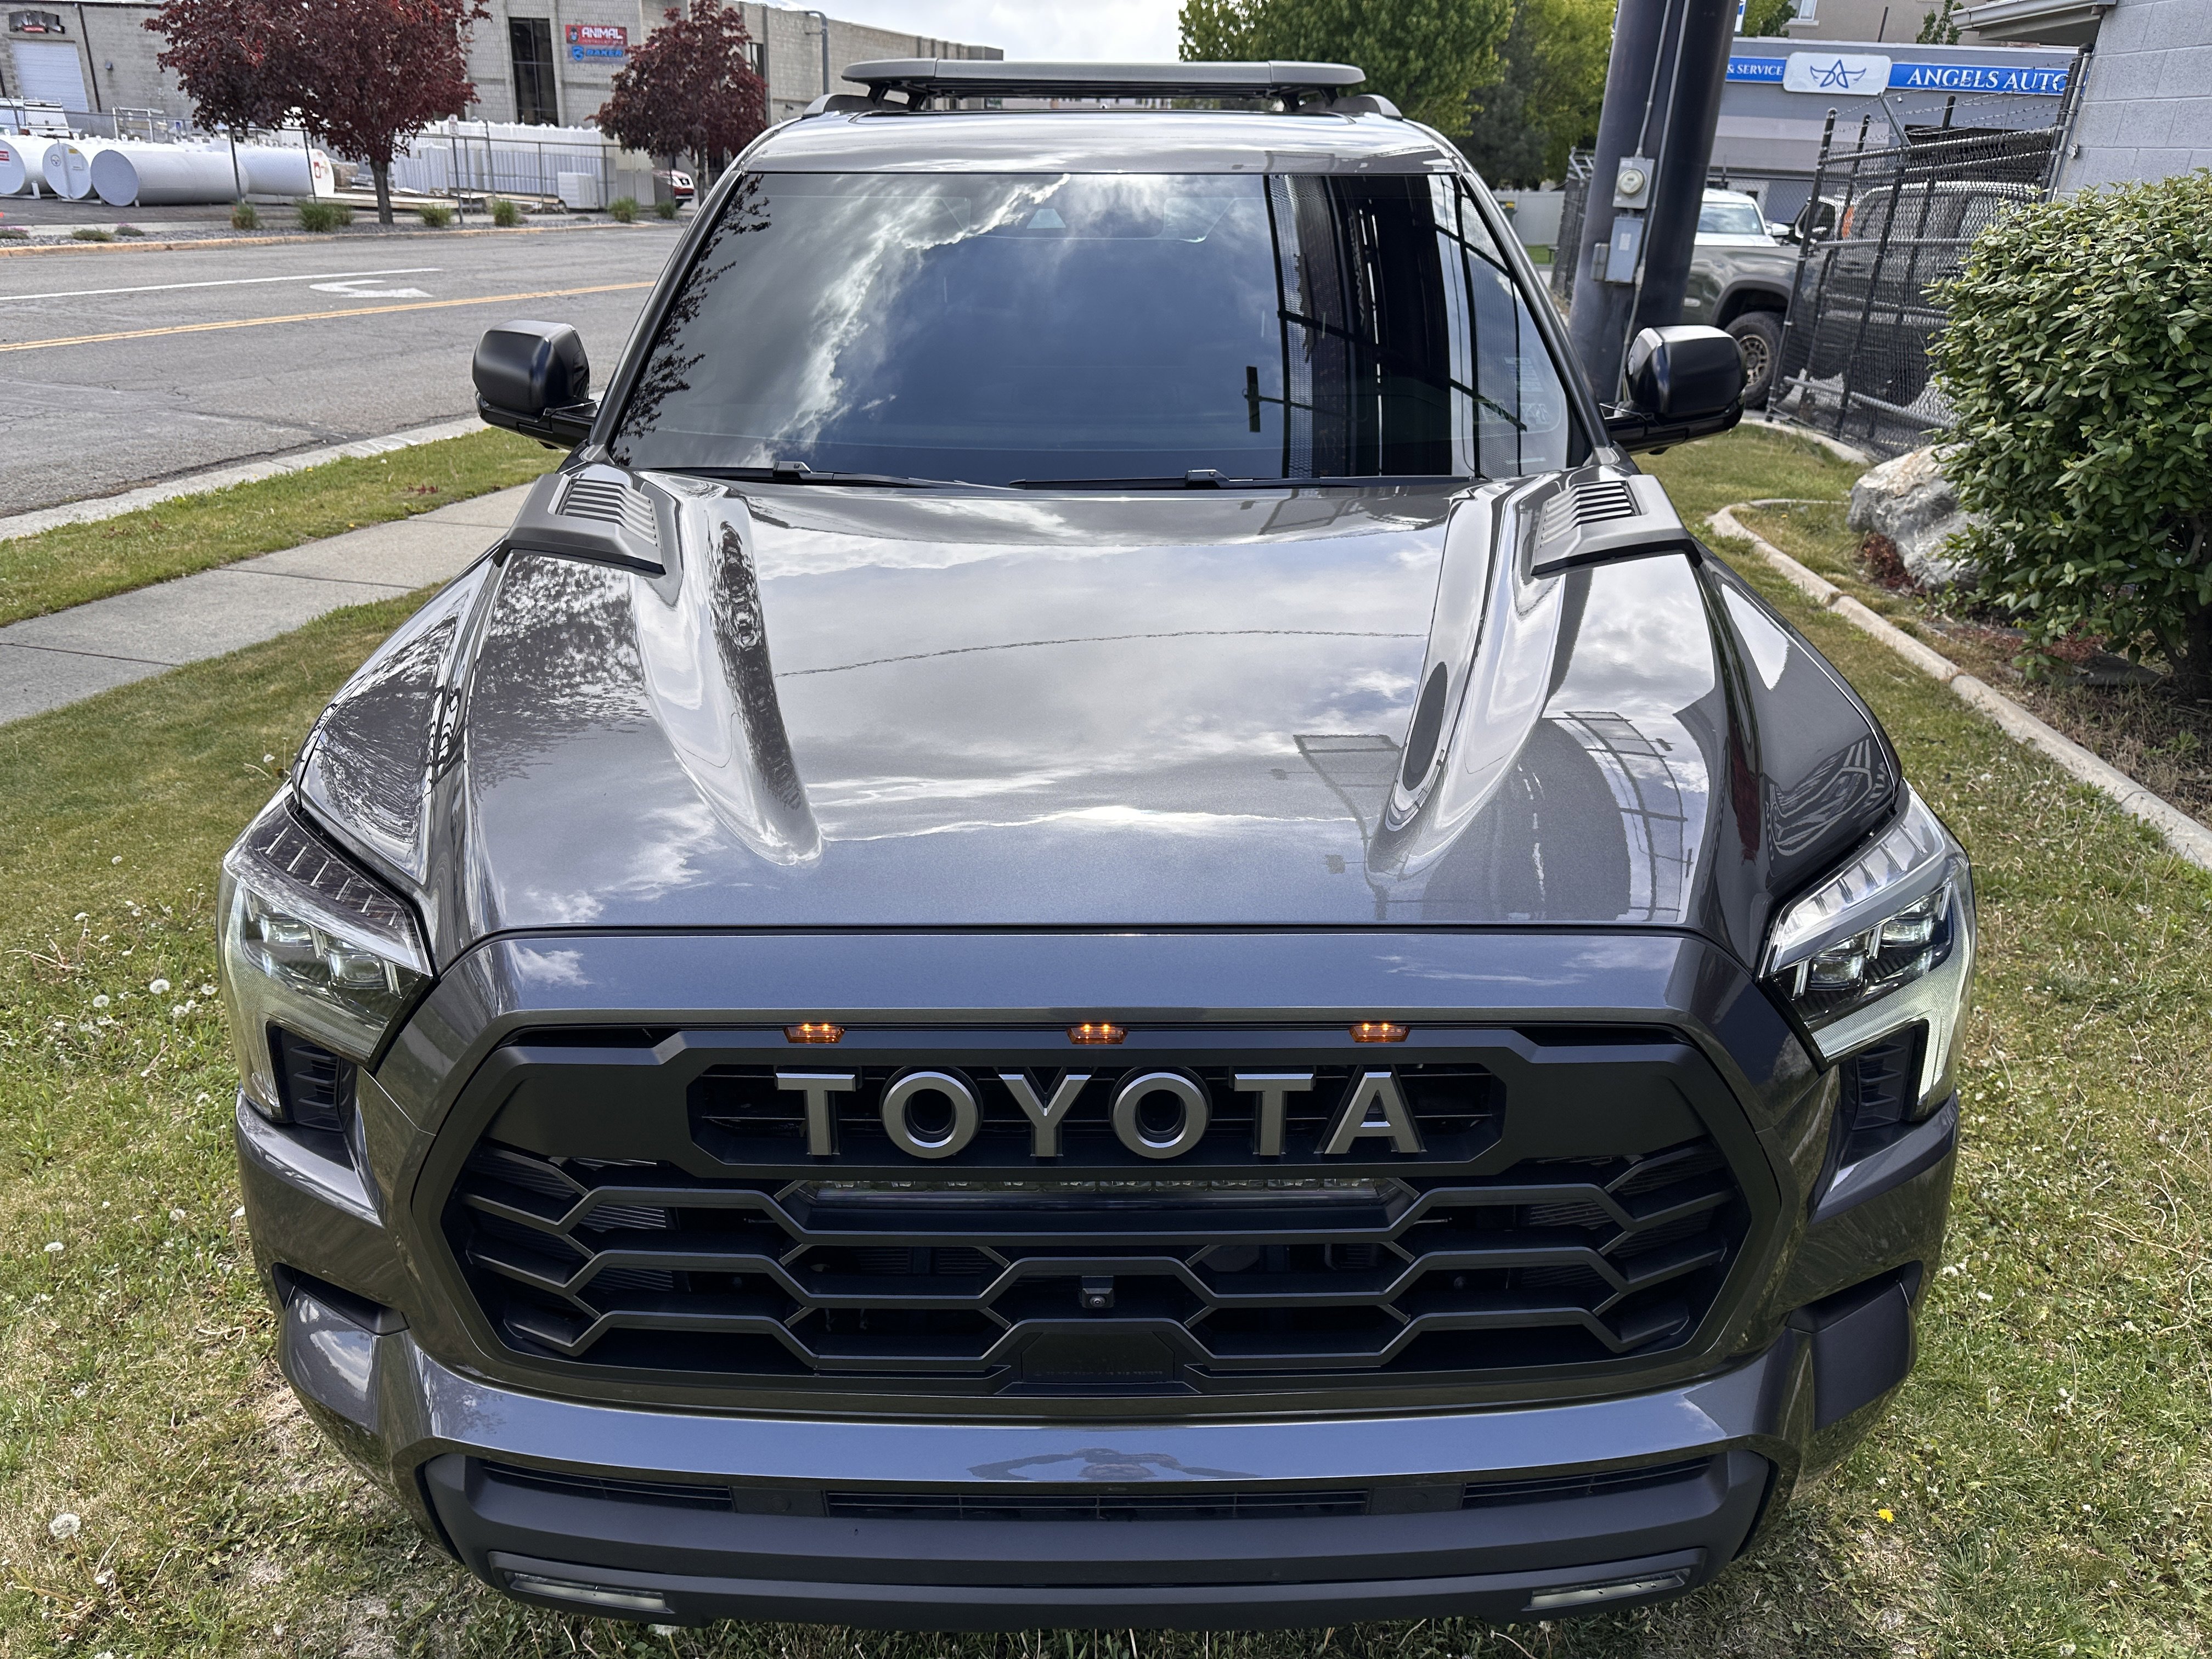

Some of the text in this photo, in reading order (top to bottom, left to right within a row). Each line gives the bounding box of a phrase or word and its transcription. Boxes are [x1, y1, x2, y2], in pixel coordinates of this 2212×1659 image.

[582, 27, 623, 39] ANIMAL
[586, 49, 623, 58] BAKER
[1726, 63, 1784, 76] & SERVICE
[1908, 67, 1999, 88] ANGELS
[776, 1068, 1426, 1159] TOYOTA
